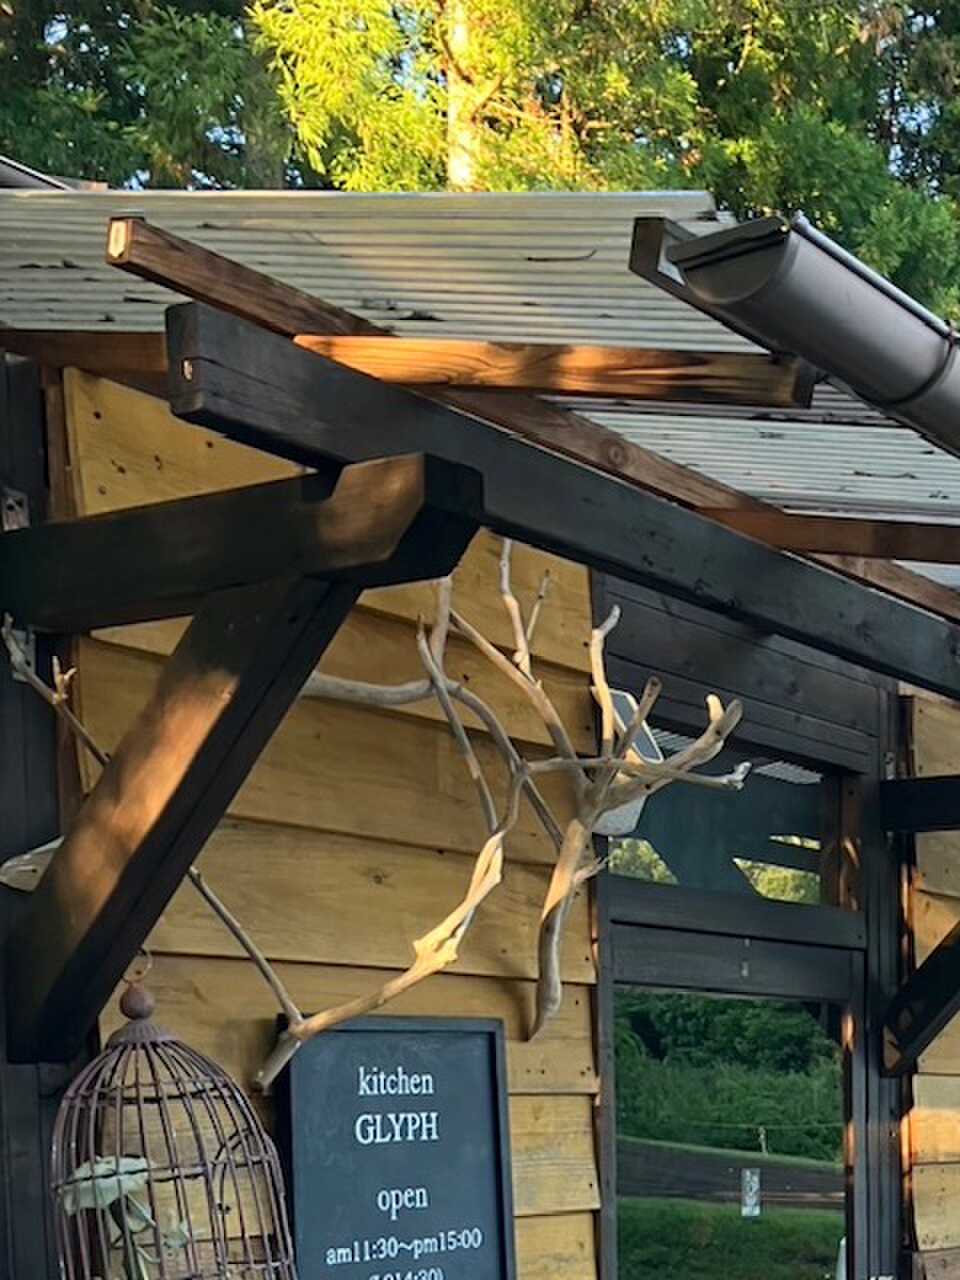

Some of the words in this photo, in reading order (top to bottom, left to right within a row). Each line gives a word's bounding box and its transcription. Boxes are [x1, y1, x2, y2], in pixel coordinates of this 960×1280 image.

[357, 1065, 435, 1096] kitchen
[354, 1111, 440, 1145] GLYPH
[377, 1186, 429, 1221] open
